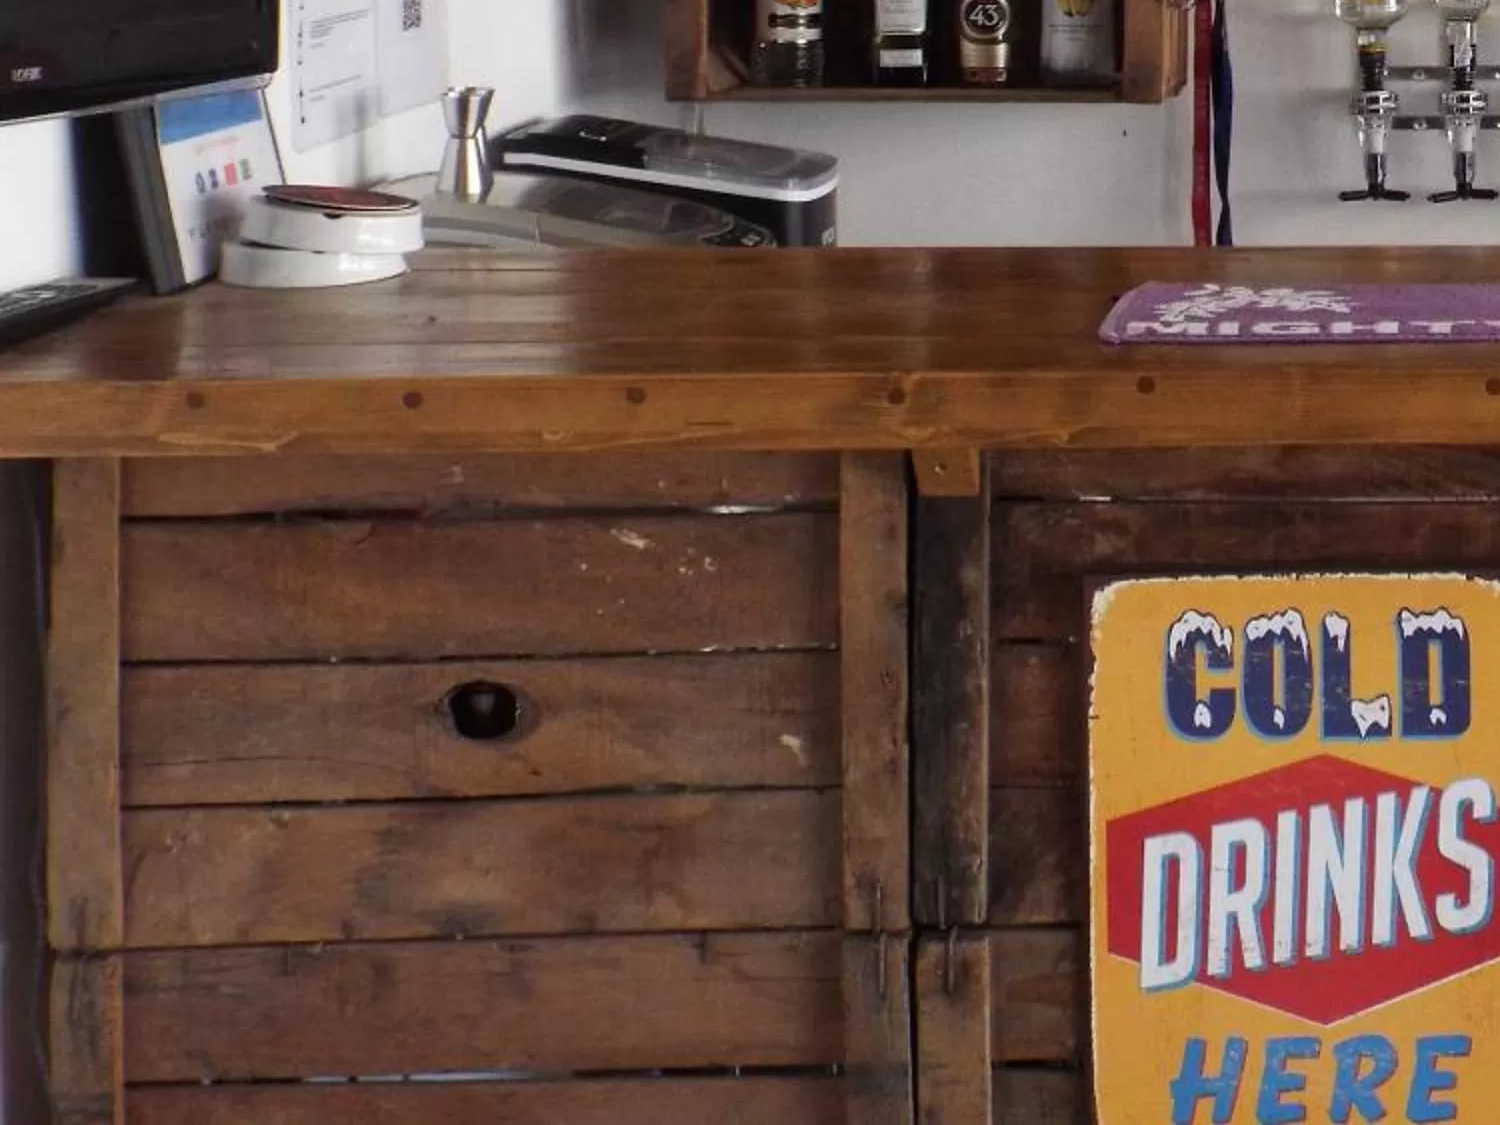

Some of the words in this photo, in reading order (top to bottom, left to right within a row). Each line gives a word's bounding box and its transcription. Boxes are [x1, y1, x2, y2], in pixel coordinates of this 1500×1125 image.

[969, 4, 1001, 27] 43
[1165, 606, 1472, 742] COLD
[1140, 777, 1498, 994] DRINKS
[1169, 1034, 1472, 1124] HERE
